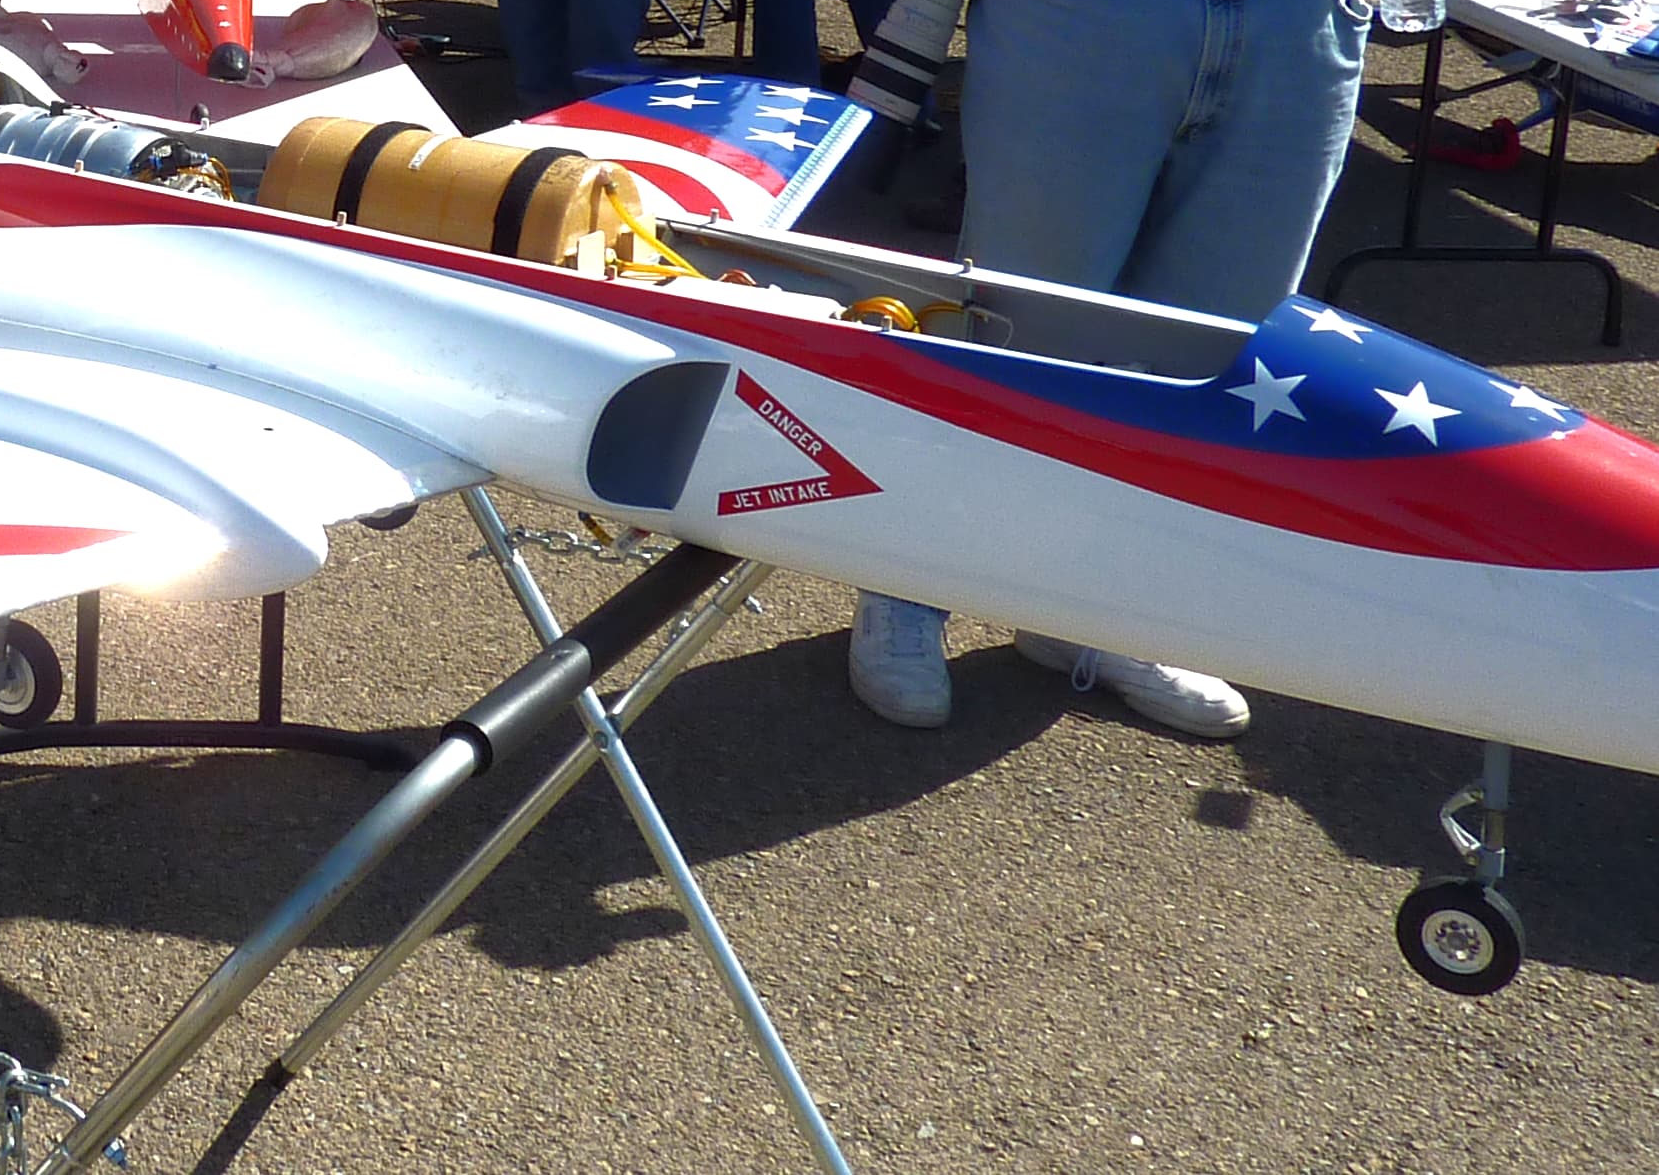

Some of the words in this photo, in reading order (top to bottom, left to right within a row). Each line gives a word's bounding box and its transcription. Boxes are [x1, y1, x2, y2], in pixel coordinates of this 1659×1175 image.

[758, 399, 824, 458] DANGER
[731, 491, 762, 510] JET
[768, 481, 833, 505] INTAKE
